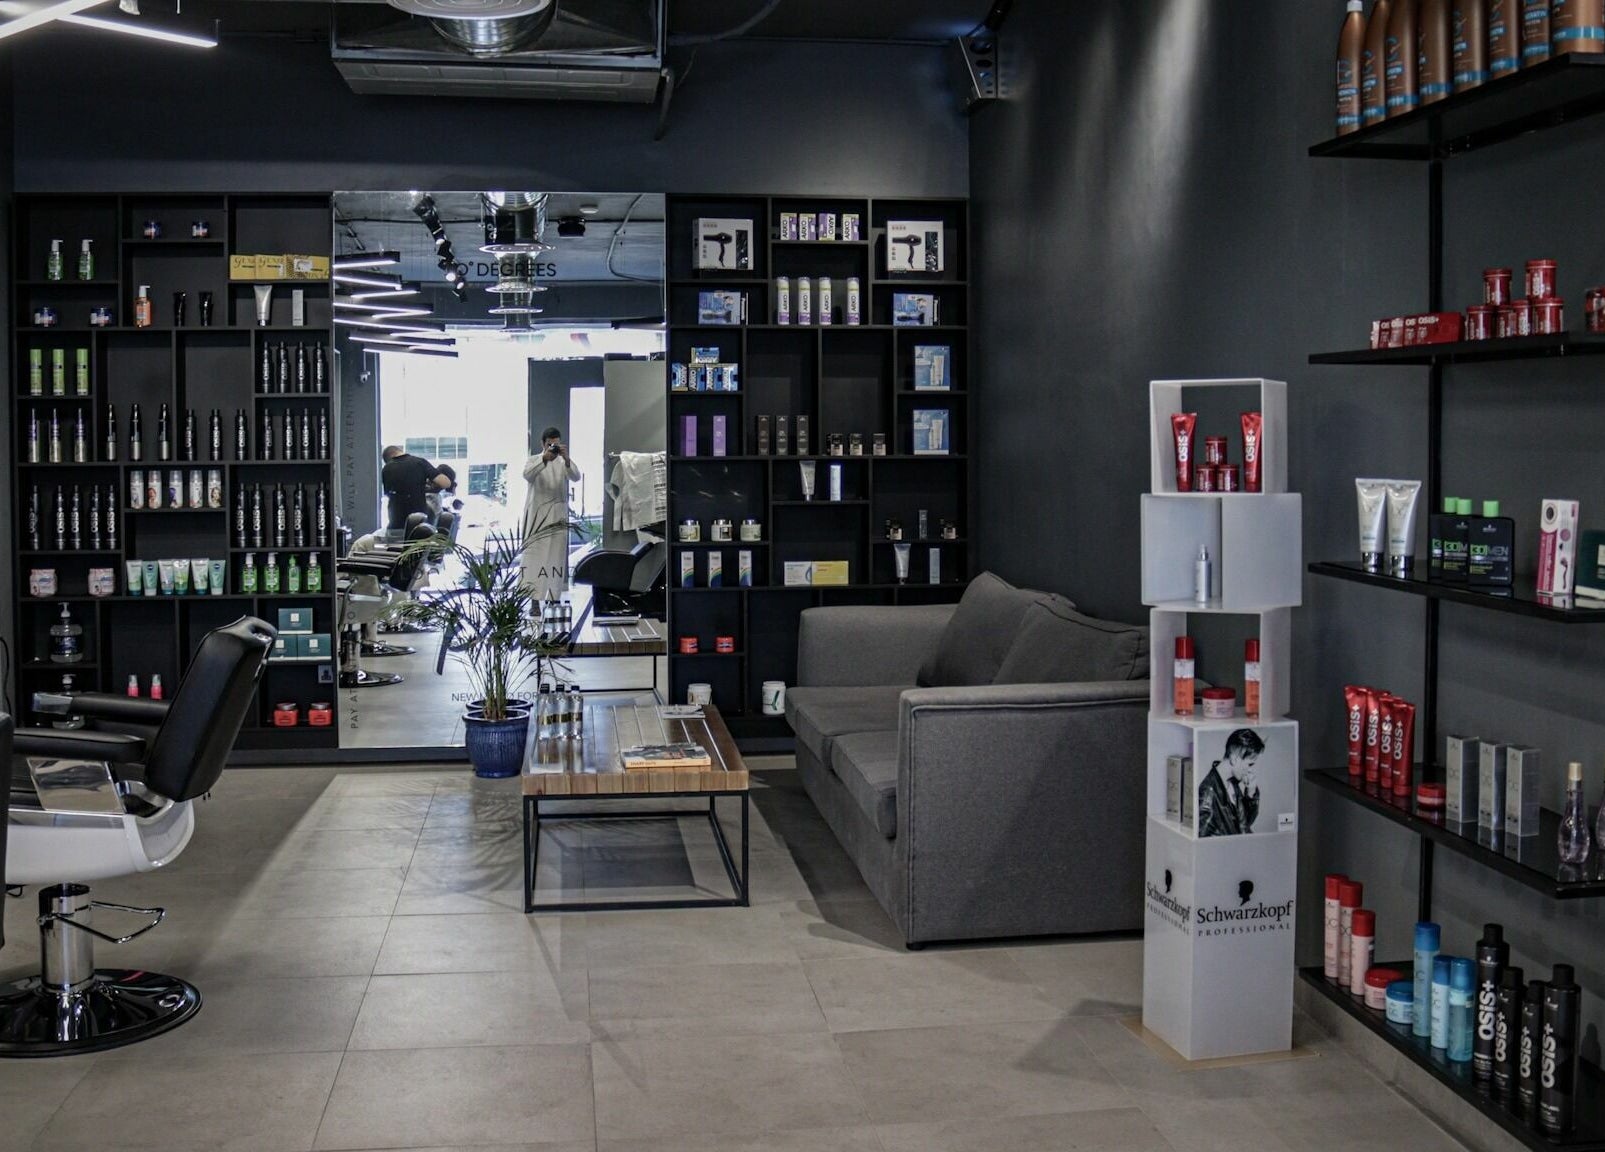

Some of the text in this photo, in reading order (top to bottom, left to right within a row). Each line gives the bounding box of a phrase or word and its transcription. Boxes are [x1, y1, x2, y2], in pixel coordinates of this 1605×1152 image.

[477, 262, 557, 277] DEGREES
[452, 692, 476, 702] NEW
[1147, 881, 1191, 923] Schwarzkopf
[1197, 900, 1294, 924] Schwarzkopf
[1198, 923, 1291, 937] PROFESSIONAL
